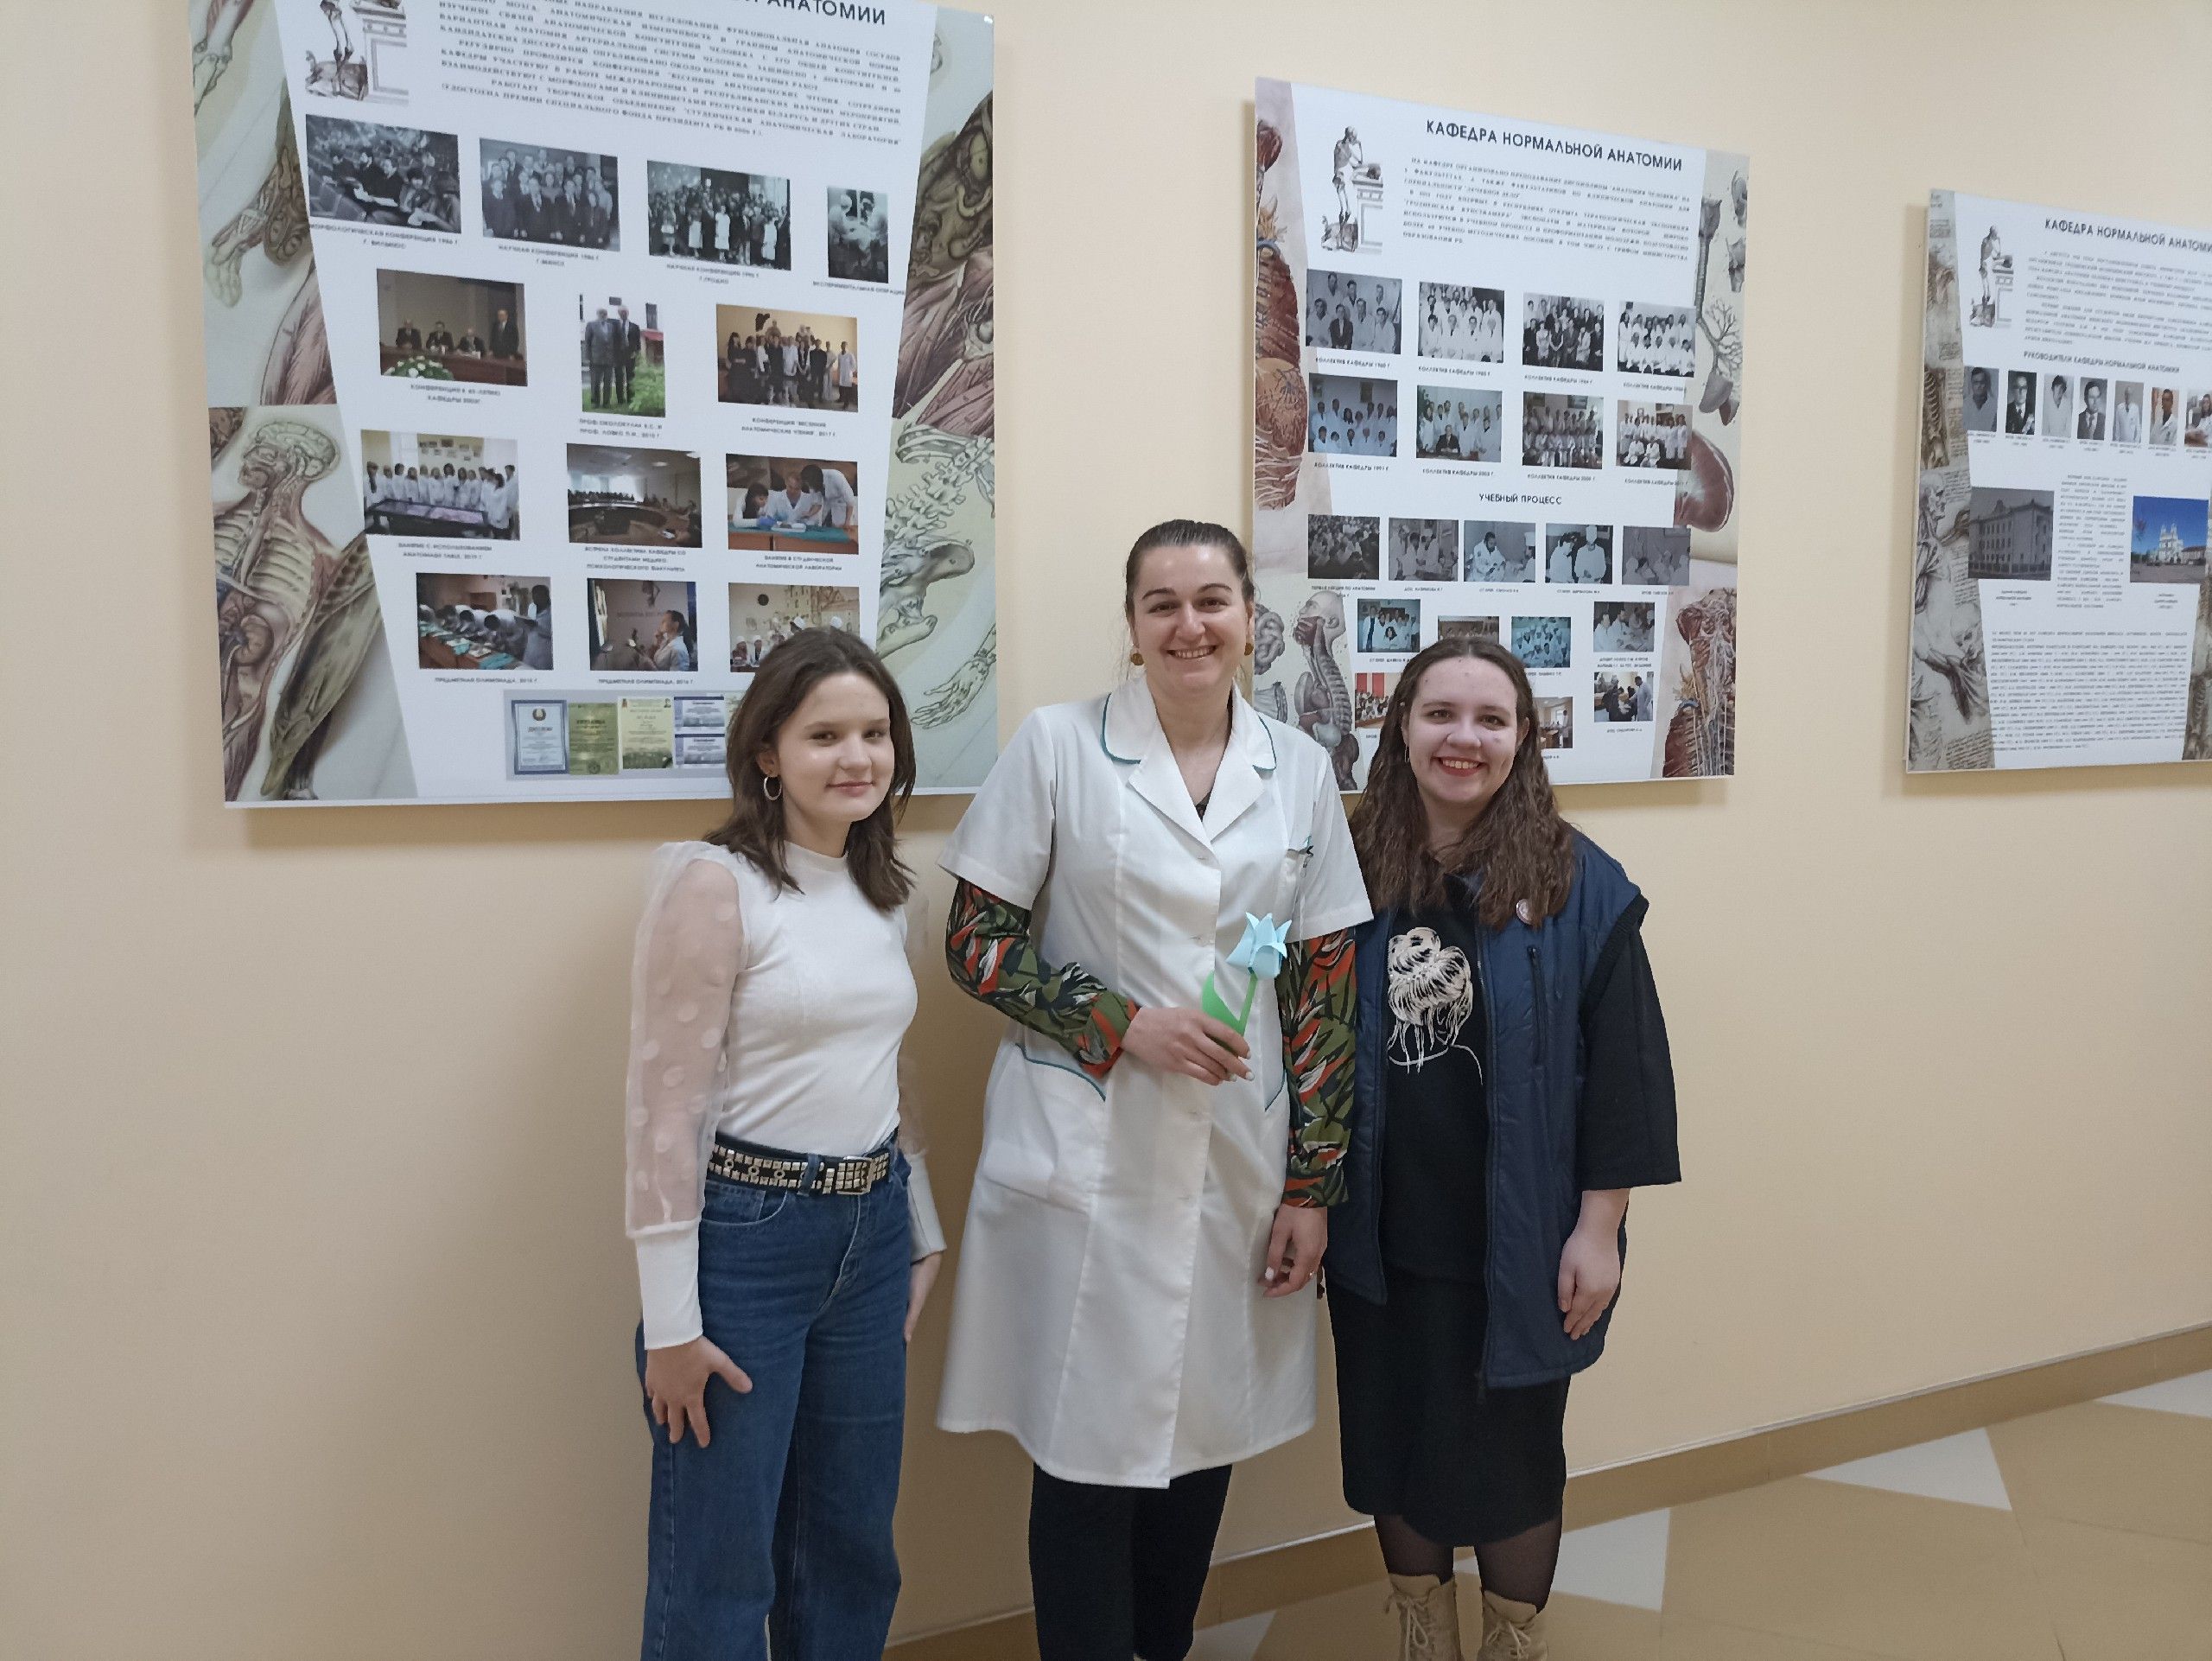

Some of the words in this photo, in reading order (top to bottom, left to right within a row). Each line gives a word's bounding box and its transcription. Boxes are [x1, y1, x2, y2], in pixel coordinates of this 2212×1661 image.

[1427, 119, 1496, 143] КАФЕДРА
[1503, 131, 1602, 159] НОРМАЛЬНОЙ
[1607, 147, 1681, 171] АНАТОМИИ
[2045, 218, 2093, 236] КАФЕДРА
[2097, 226, 2164, 246] НОРМАЛЬНОЙ
[1479, 492, 1517, 503] УЧЕБНЫЙ
[1521, 493, 1560, 505] ПРОЦЕСС
